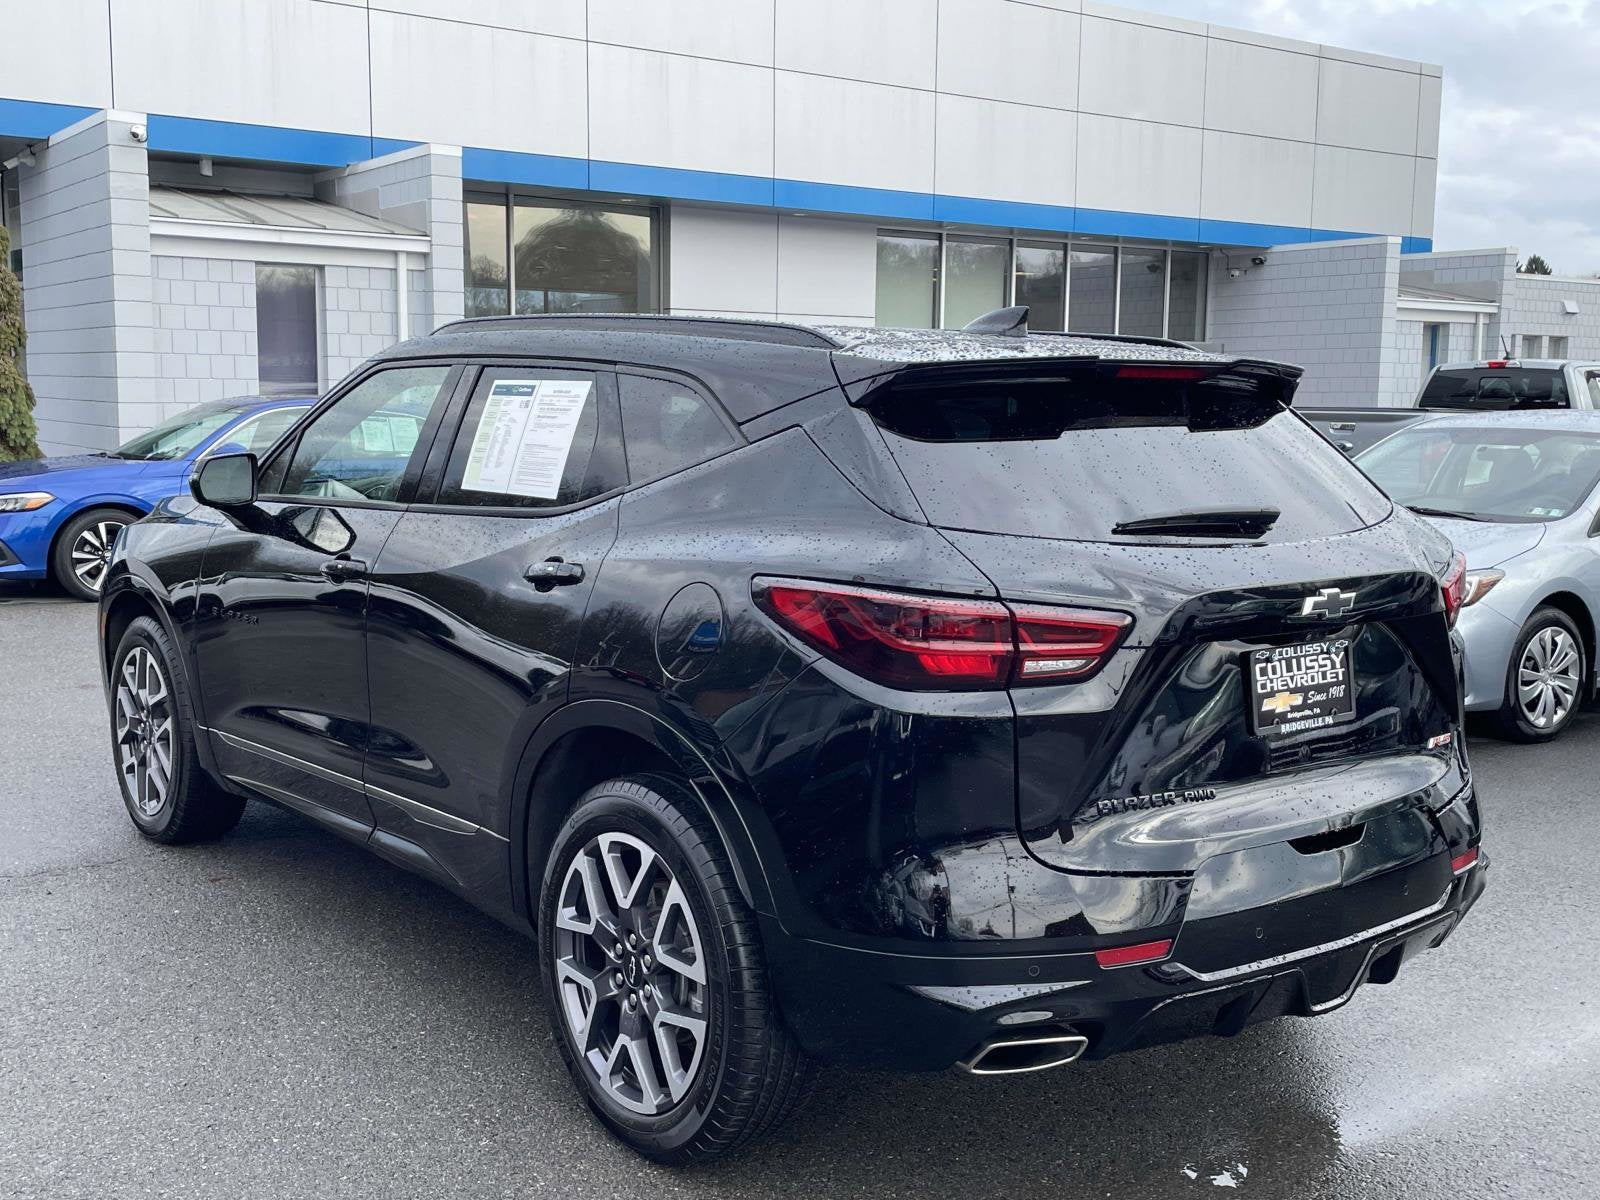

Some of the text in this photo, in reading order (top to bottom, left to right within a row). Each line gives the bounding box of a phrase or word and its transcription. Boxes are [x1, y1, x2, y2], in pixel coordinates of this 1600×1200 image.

[1275, 641, 1330, 659] COLUSSY
[1255, 651, 1345, 681] COLUSSY
[1256, 668, 1346, 693] CHEVROLET
[1307, 684, 1346, 703] Since 1918
[1313, 707, 1321, 715] PA
[1325, 715, 1334, 725] PA
[1097, 791, 1176, 816] BLAZER
